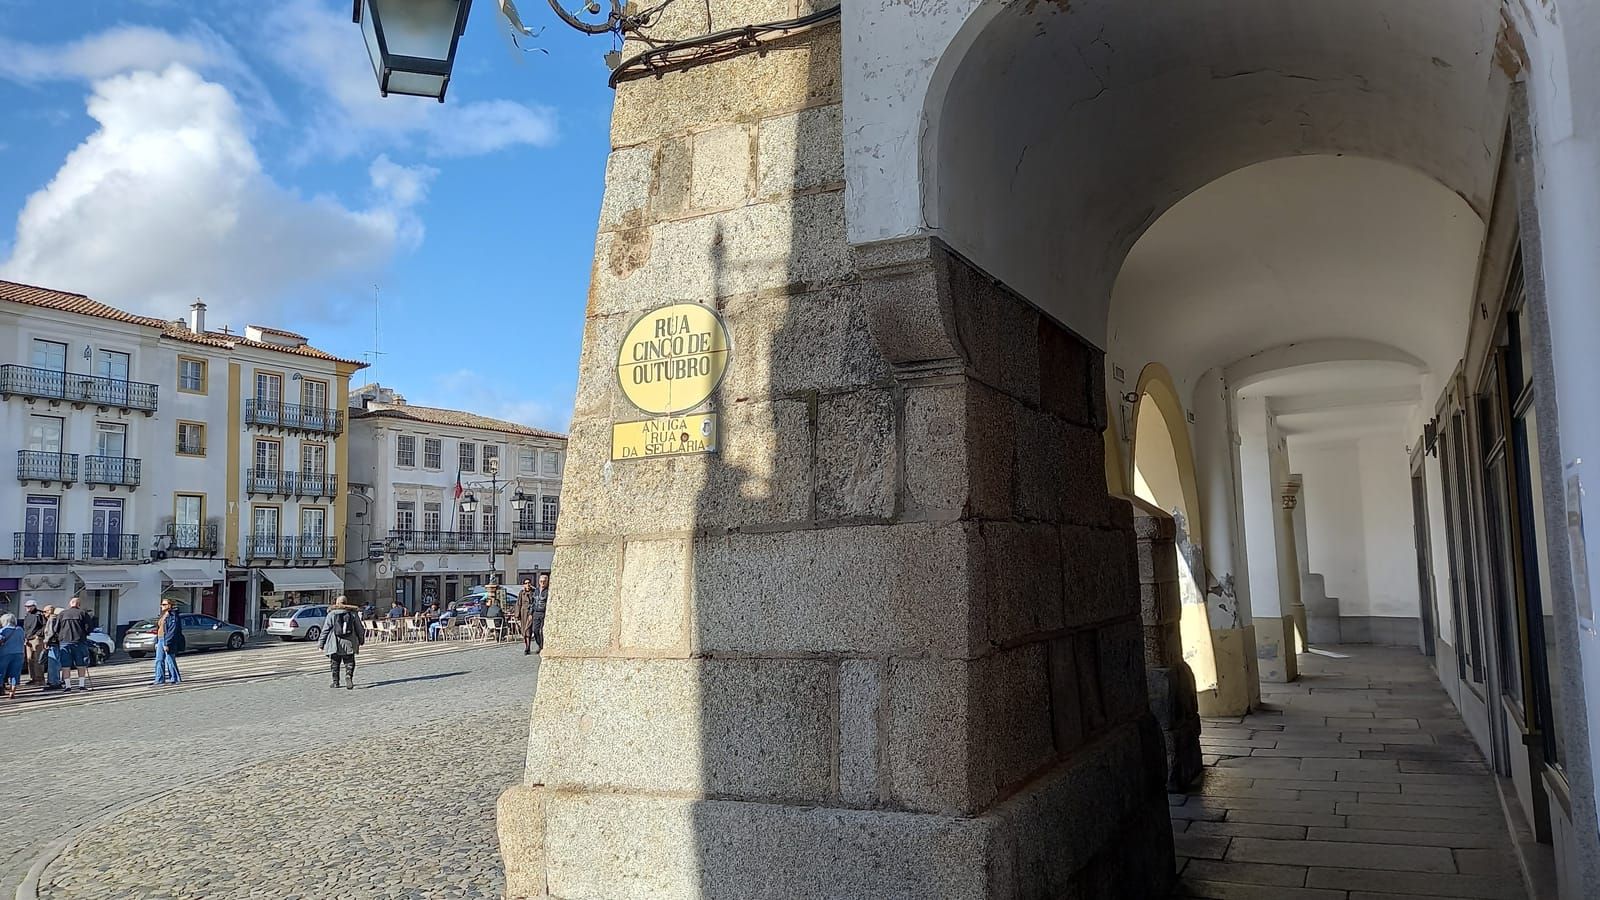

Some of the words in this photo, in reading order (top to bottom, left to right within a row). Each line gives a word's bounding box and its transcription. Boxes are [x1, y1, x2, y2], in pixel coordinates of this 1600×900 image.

[655, 314, 690, 338] RUA
[633, 336, 684, 362] CINCO
[688, 332, 711, 353] DE
[633, 356, 711, 385] OUTUBRO
[642, 419, 688, 433] ANTIGA
[651, 432, 676, 443] RUA
[622, 446, 638, 458] DA
[645, 439, 706, 455] SELLARIA
